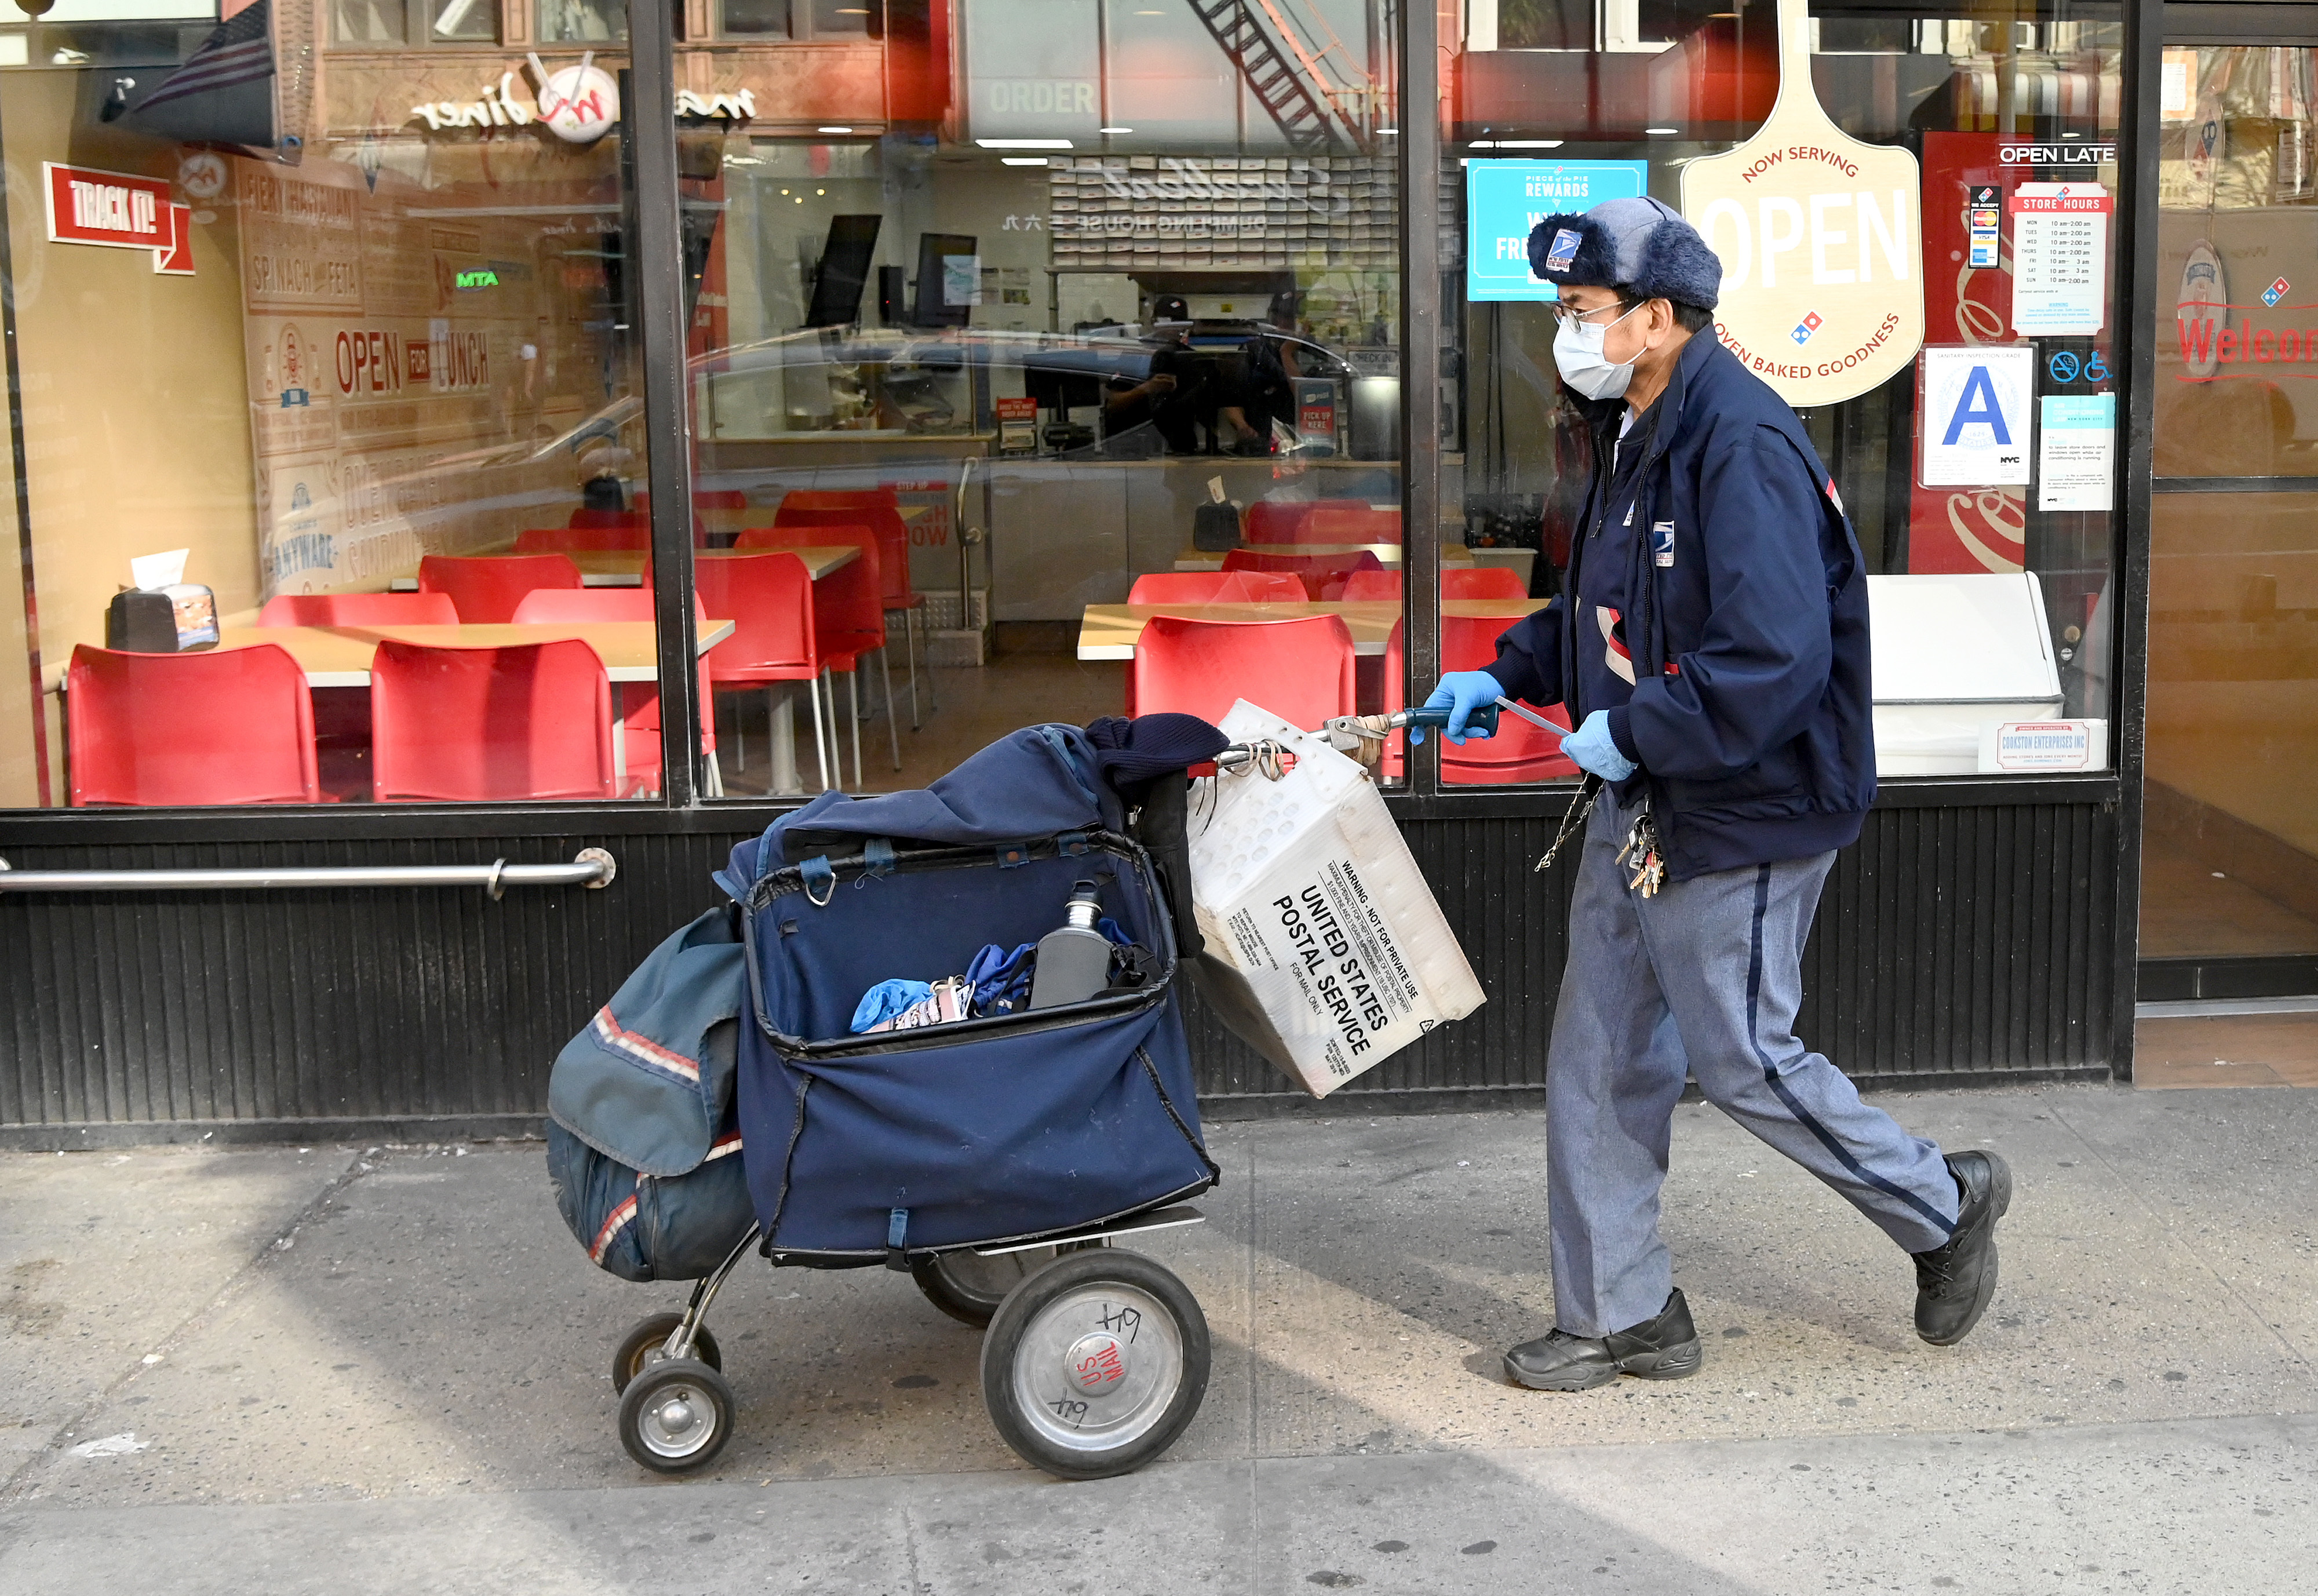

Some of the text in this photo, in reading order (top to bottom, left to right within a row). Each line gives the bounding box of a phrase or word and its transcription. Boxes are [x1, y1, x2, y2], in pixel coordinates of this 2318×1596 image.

[990, 84, 1094, 113] ORDER
[1742, 147, 1859, 183] NOW SERVING
[2000, 147, 2115, 163] OPEN LATE
[1526, 183, 1588, 197] REWARDS
[68, 180, 157, 234] TRACK IT!
[2023, 199, 2100, 209] STORE HOURS
[1496, 237, 1529, 260] FRE
[1699, 189, 1909, 290] OPEN
[1714, 312, 1900, 379] OVEN BAKED GOODNESS
[2177, 319, 2318, 363] Welco
[336, 331, 489, 394] OPEN FOR LUNCH
[1304, 412, 1320, 420] PICK
[1942, 366, 2012, 445] A
[2002, 735, 2084, 749] COOKSTON ENTERPRISES INC
[1326, 862, 1344, 889] MAXIMUM
[1326, 880, 1340, 898] $1,000
[1339, 886, 1357, 910] PENALTY
[1335, 895, 1346, 910] FINE
[1340, 908, 1351, 920] AND
[1235, 911, 1242, 919] TO
[1239, 917, 1251, 935] REPORT
[1351, 908, 1362, 923] FOR
[1241, 907, 1253, 925] RETURN
[1253, 928, 1266, 948] NEAREST
[1263, 946, 1272, 958] POST
[1269, 956, 1280, 971] OFFICE
[1342, 859, 1369, 904] WARNING
[1365, 907, 1382, 928] NOT
[1374, 926, 1391, 948] FOR
[1384, 945, 1410, 982] PRIVATE
[1403, 980, 1419, 1000] USE
[1349, 921, 1362, 941] YEARS
[1356, 919, 1371, 939] THEFT
[1300, 884, 1388, 1032] UNITED STATES
[1369, 943, 1384, 965] MISUSE
[1379, 962, 1388, 970] OF
[1272, 895, 1372, 1056] POSTAL SERVICE
[1383, 969, 1398, 990] POSTAL
[1289, 961, 1324, 1016] FOR MAIL ONLY
[1380, 982, 1391, 995] USC
[1393, 987, 1411, 1014] PROPERTY
[1324, 1053, 1333, 1064] MAY
[1077, 1356, 1102, 1387] US
[1095, 1341, 1125, 1382] MAIL
